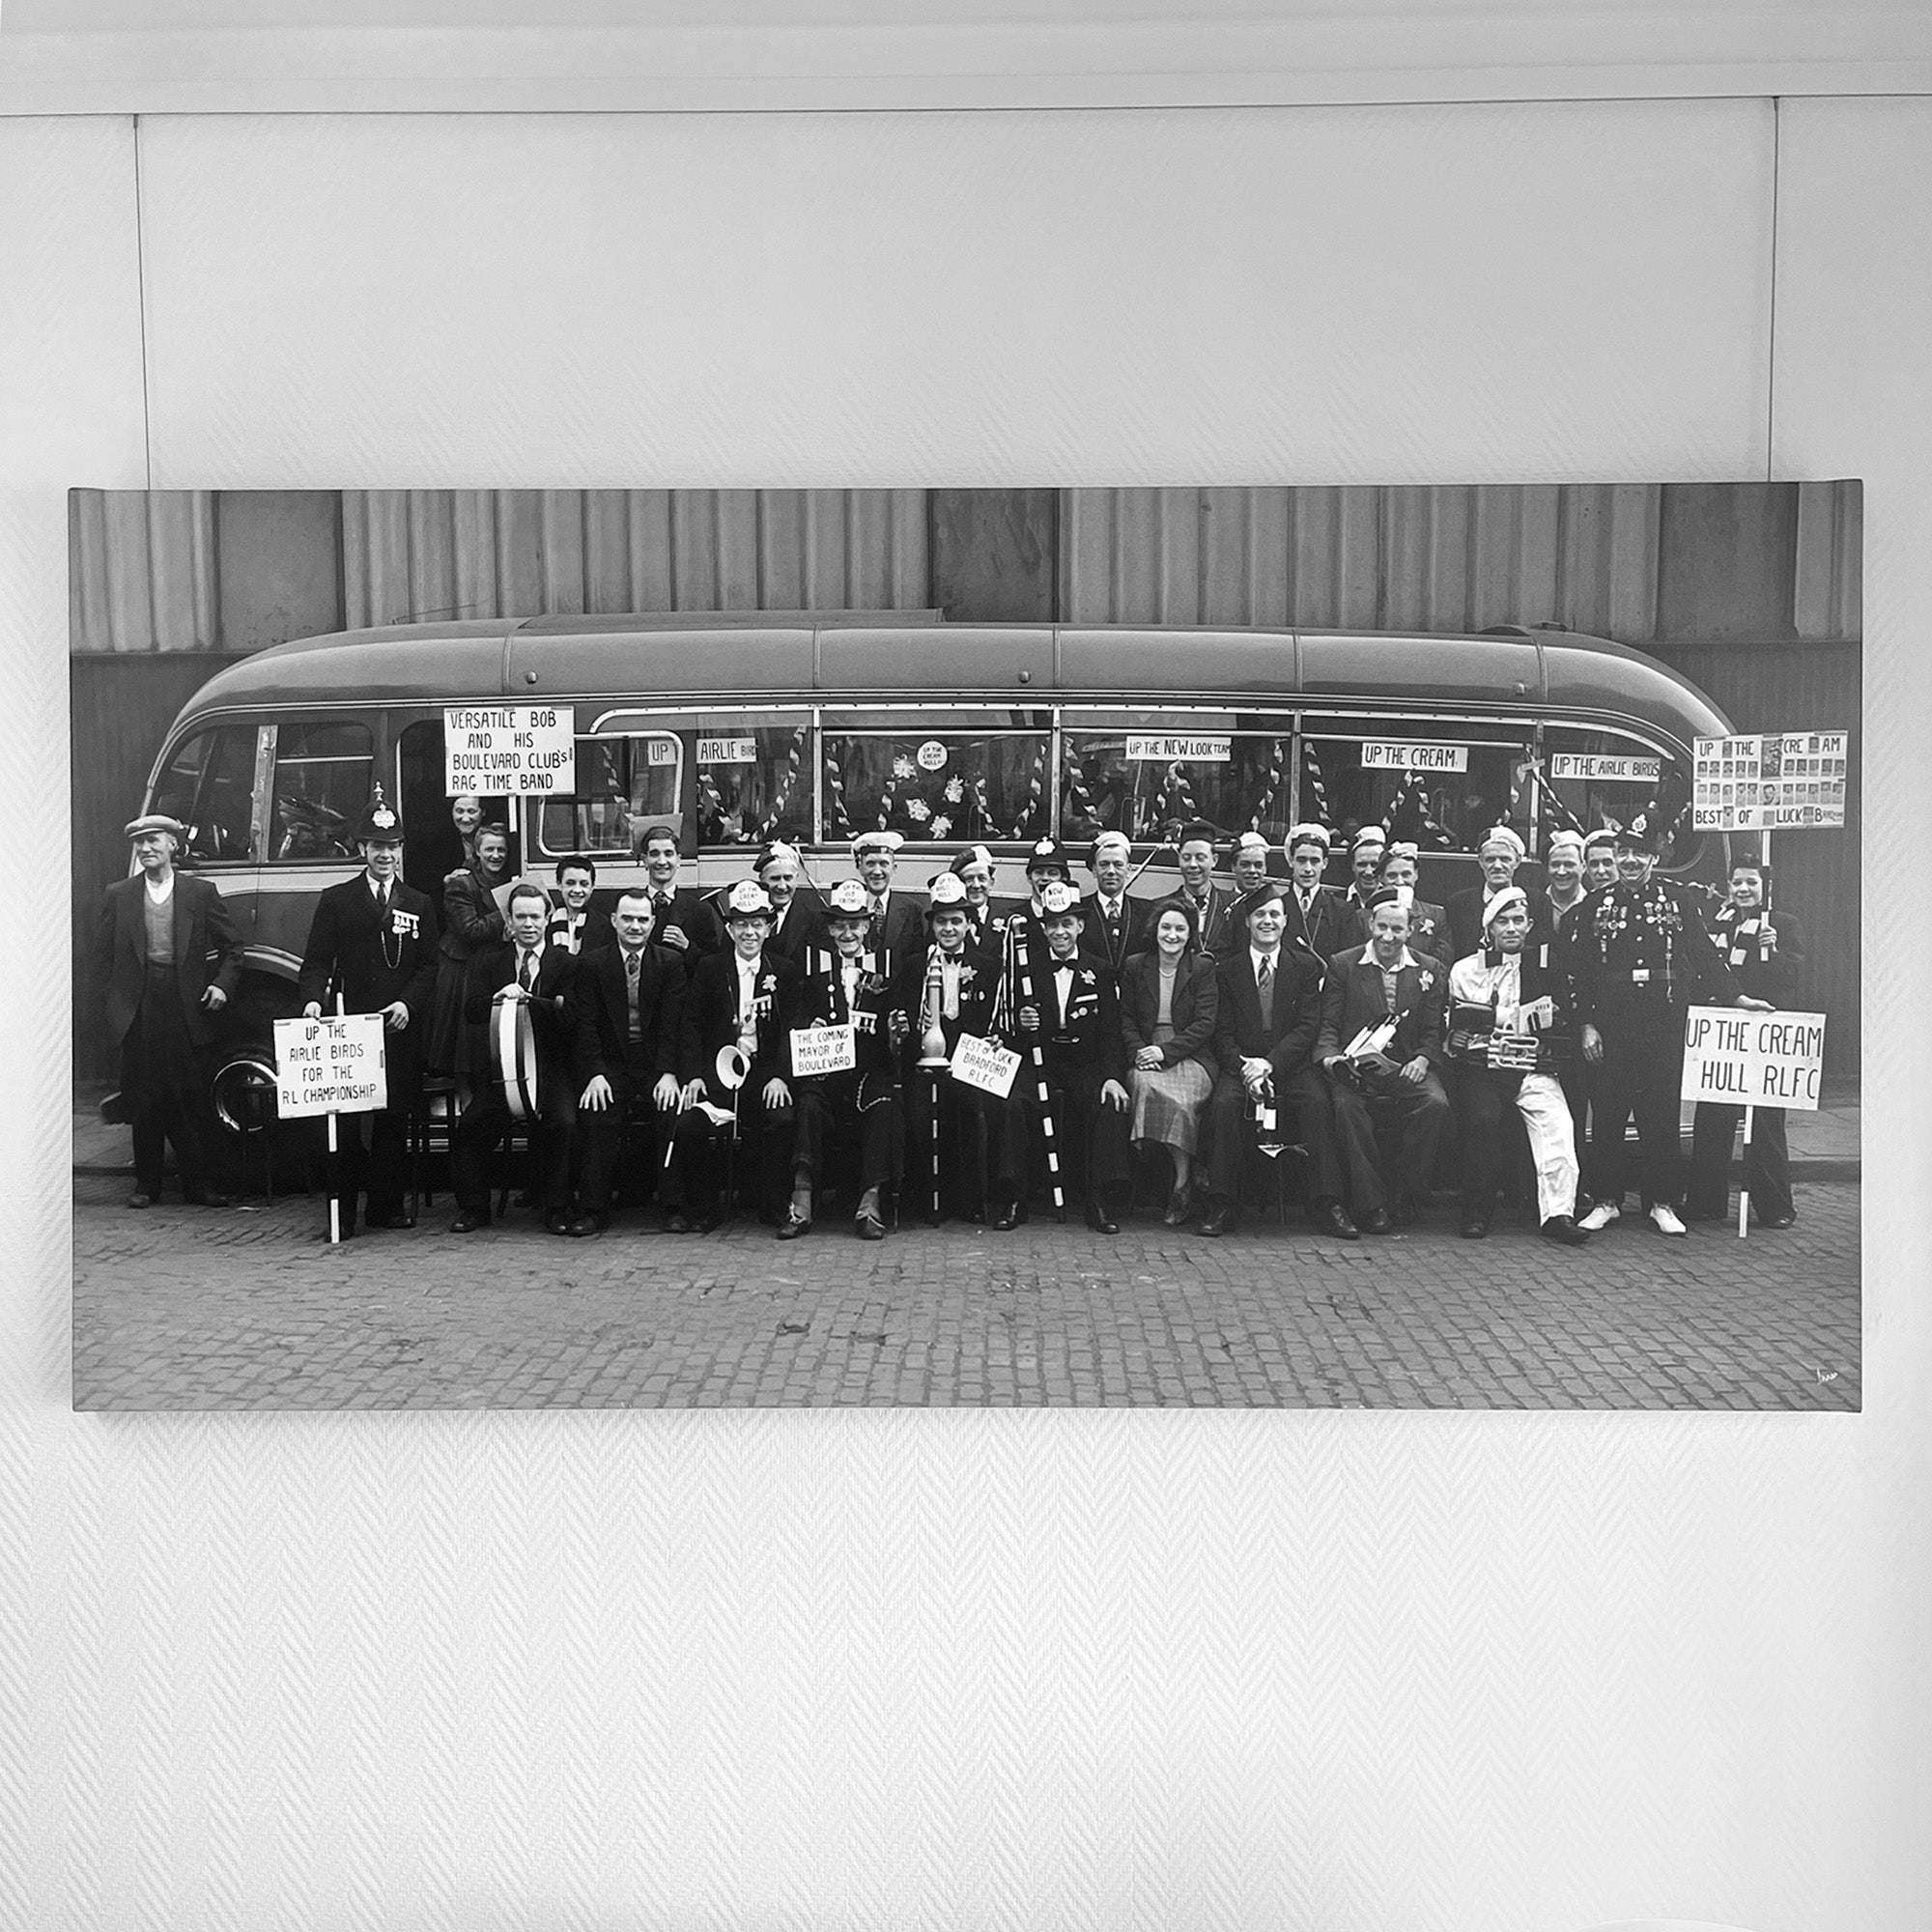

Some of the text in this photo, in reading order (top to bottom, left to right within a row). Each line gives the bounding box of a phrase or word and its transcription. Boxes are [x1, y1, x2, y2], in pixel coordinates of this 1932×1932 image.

[450, 711, 556, 728] VERSATILE BOB
[468, 732, 534, 749] AND HIS
[1129, 741, 1142, 754] UP
[1144, 741, 1159, 754] THE
[1164, 739, 1188, 755] NEW
[1190, 742, 1212, 755] LOOK
[1699, 742, 1715, 756] UP
[1735, 741, 1754, 755] THE
[652, 743, 668, 761] UP
[700, 741, 737, 760] AIRLIE
[1365, 745, 1456, 767] UP THE CREAM
[453, 753, 521, 770] BOULEVARD
[1554, 756, 1660, 777] UP THE AIRLIE BIRDS
[452, 773, 554, 790] RAG TIME BAND
[1695, 810, 1723, 824] BEST
[1739, 810, 1752, 824] OF
[1776, 809, 1803, 822] LUCK
[305, 1024, 347, 1040] UP THE
[797, 1029, 849, 1044] THE COMING
[1686, 1018, 1822, 1057] UP THE CREAM
[290, 1043, 364, 1062] AIRLIE BIRDS
[798, 1042, 846, 1058] MAYOR OF
[960, 1037, 982, 1052] BEST
[798, 1056, 851, 1072] BOULEVARD
[963, 1052, 1008, 1077] BRADFORD
[302, 1065, 354, 1082] FOR THE
[968, 1068, 995, 1087] RLFC
[1701, 1061, 1818, 1099] HULL RLFC
[303, 1083, 377, 1103] CHAMPIONSHIP
